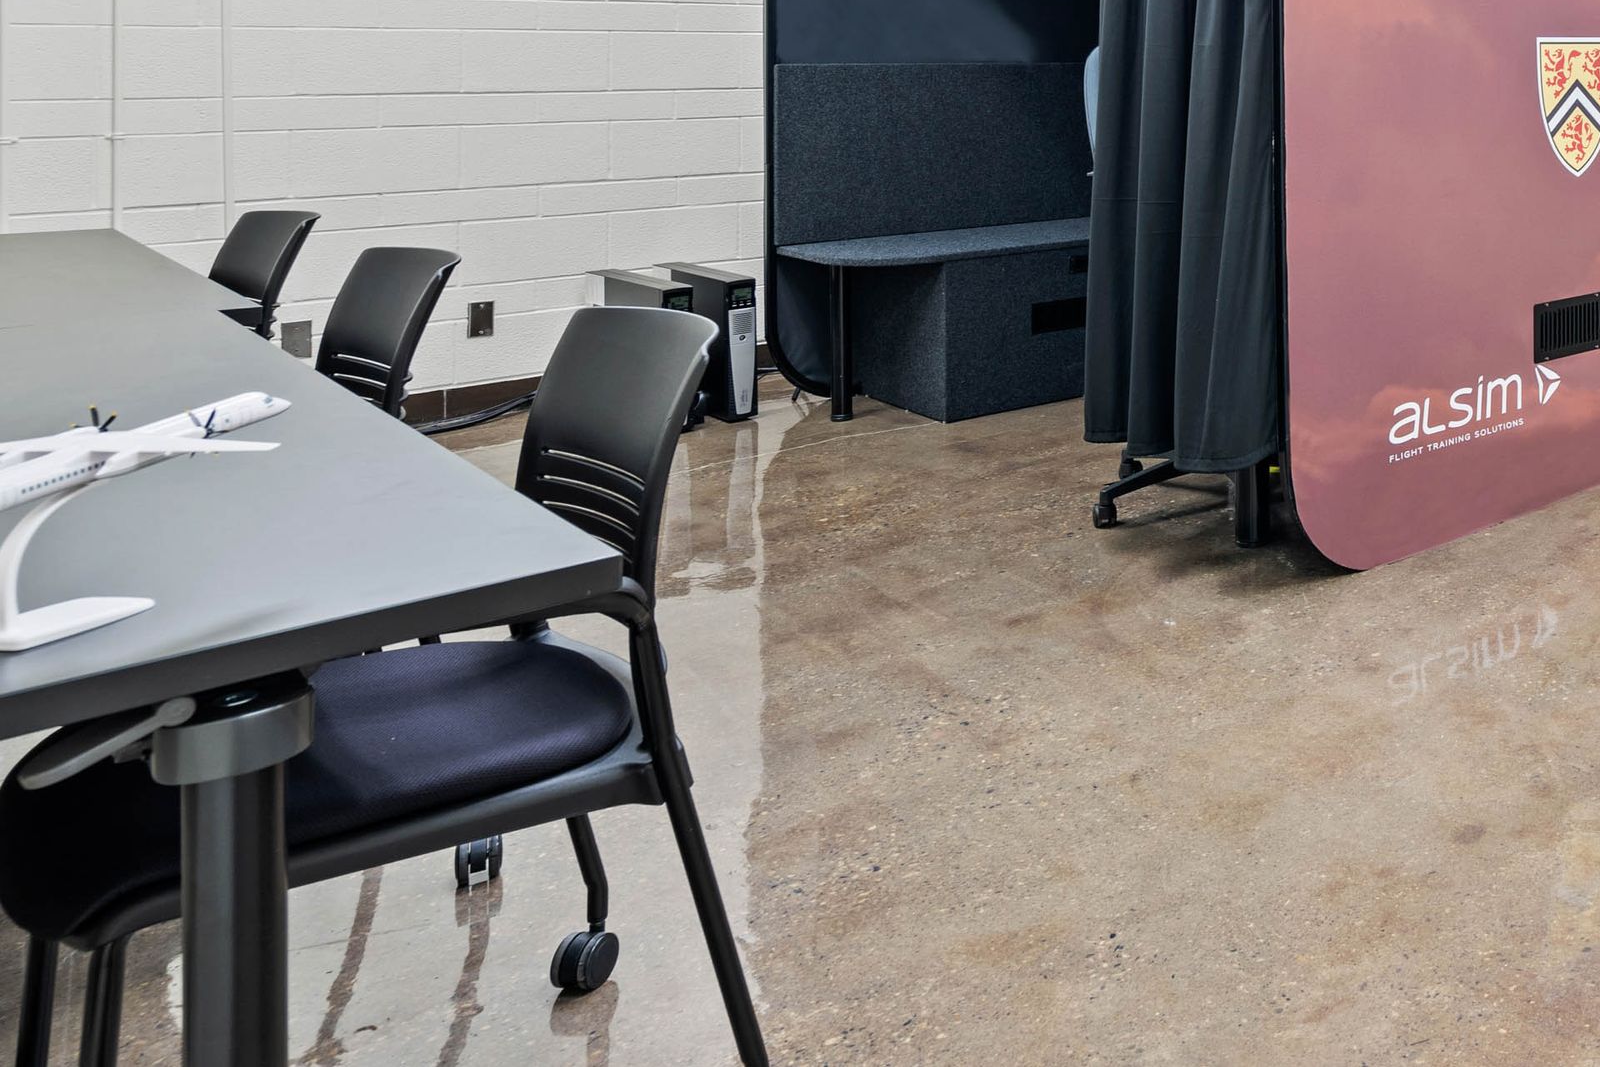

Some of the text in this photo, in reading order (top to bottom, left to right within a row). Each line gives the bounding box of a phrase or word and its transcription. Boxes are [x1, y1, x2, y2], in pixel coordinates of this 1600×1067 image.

[1388, 417, 1525, 464] FLIGHT TRAINING SOLUTIONS
